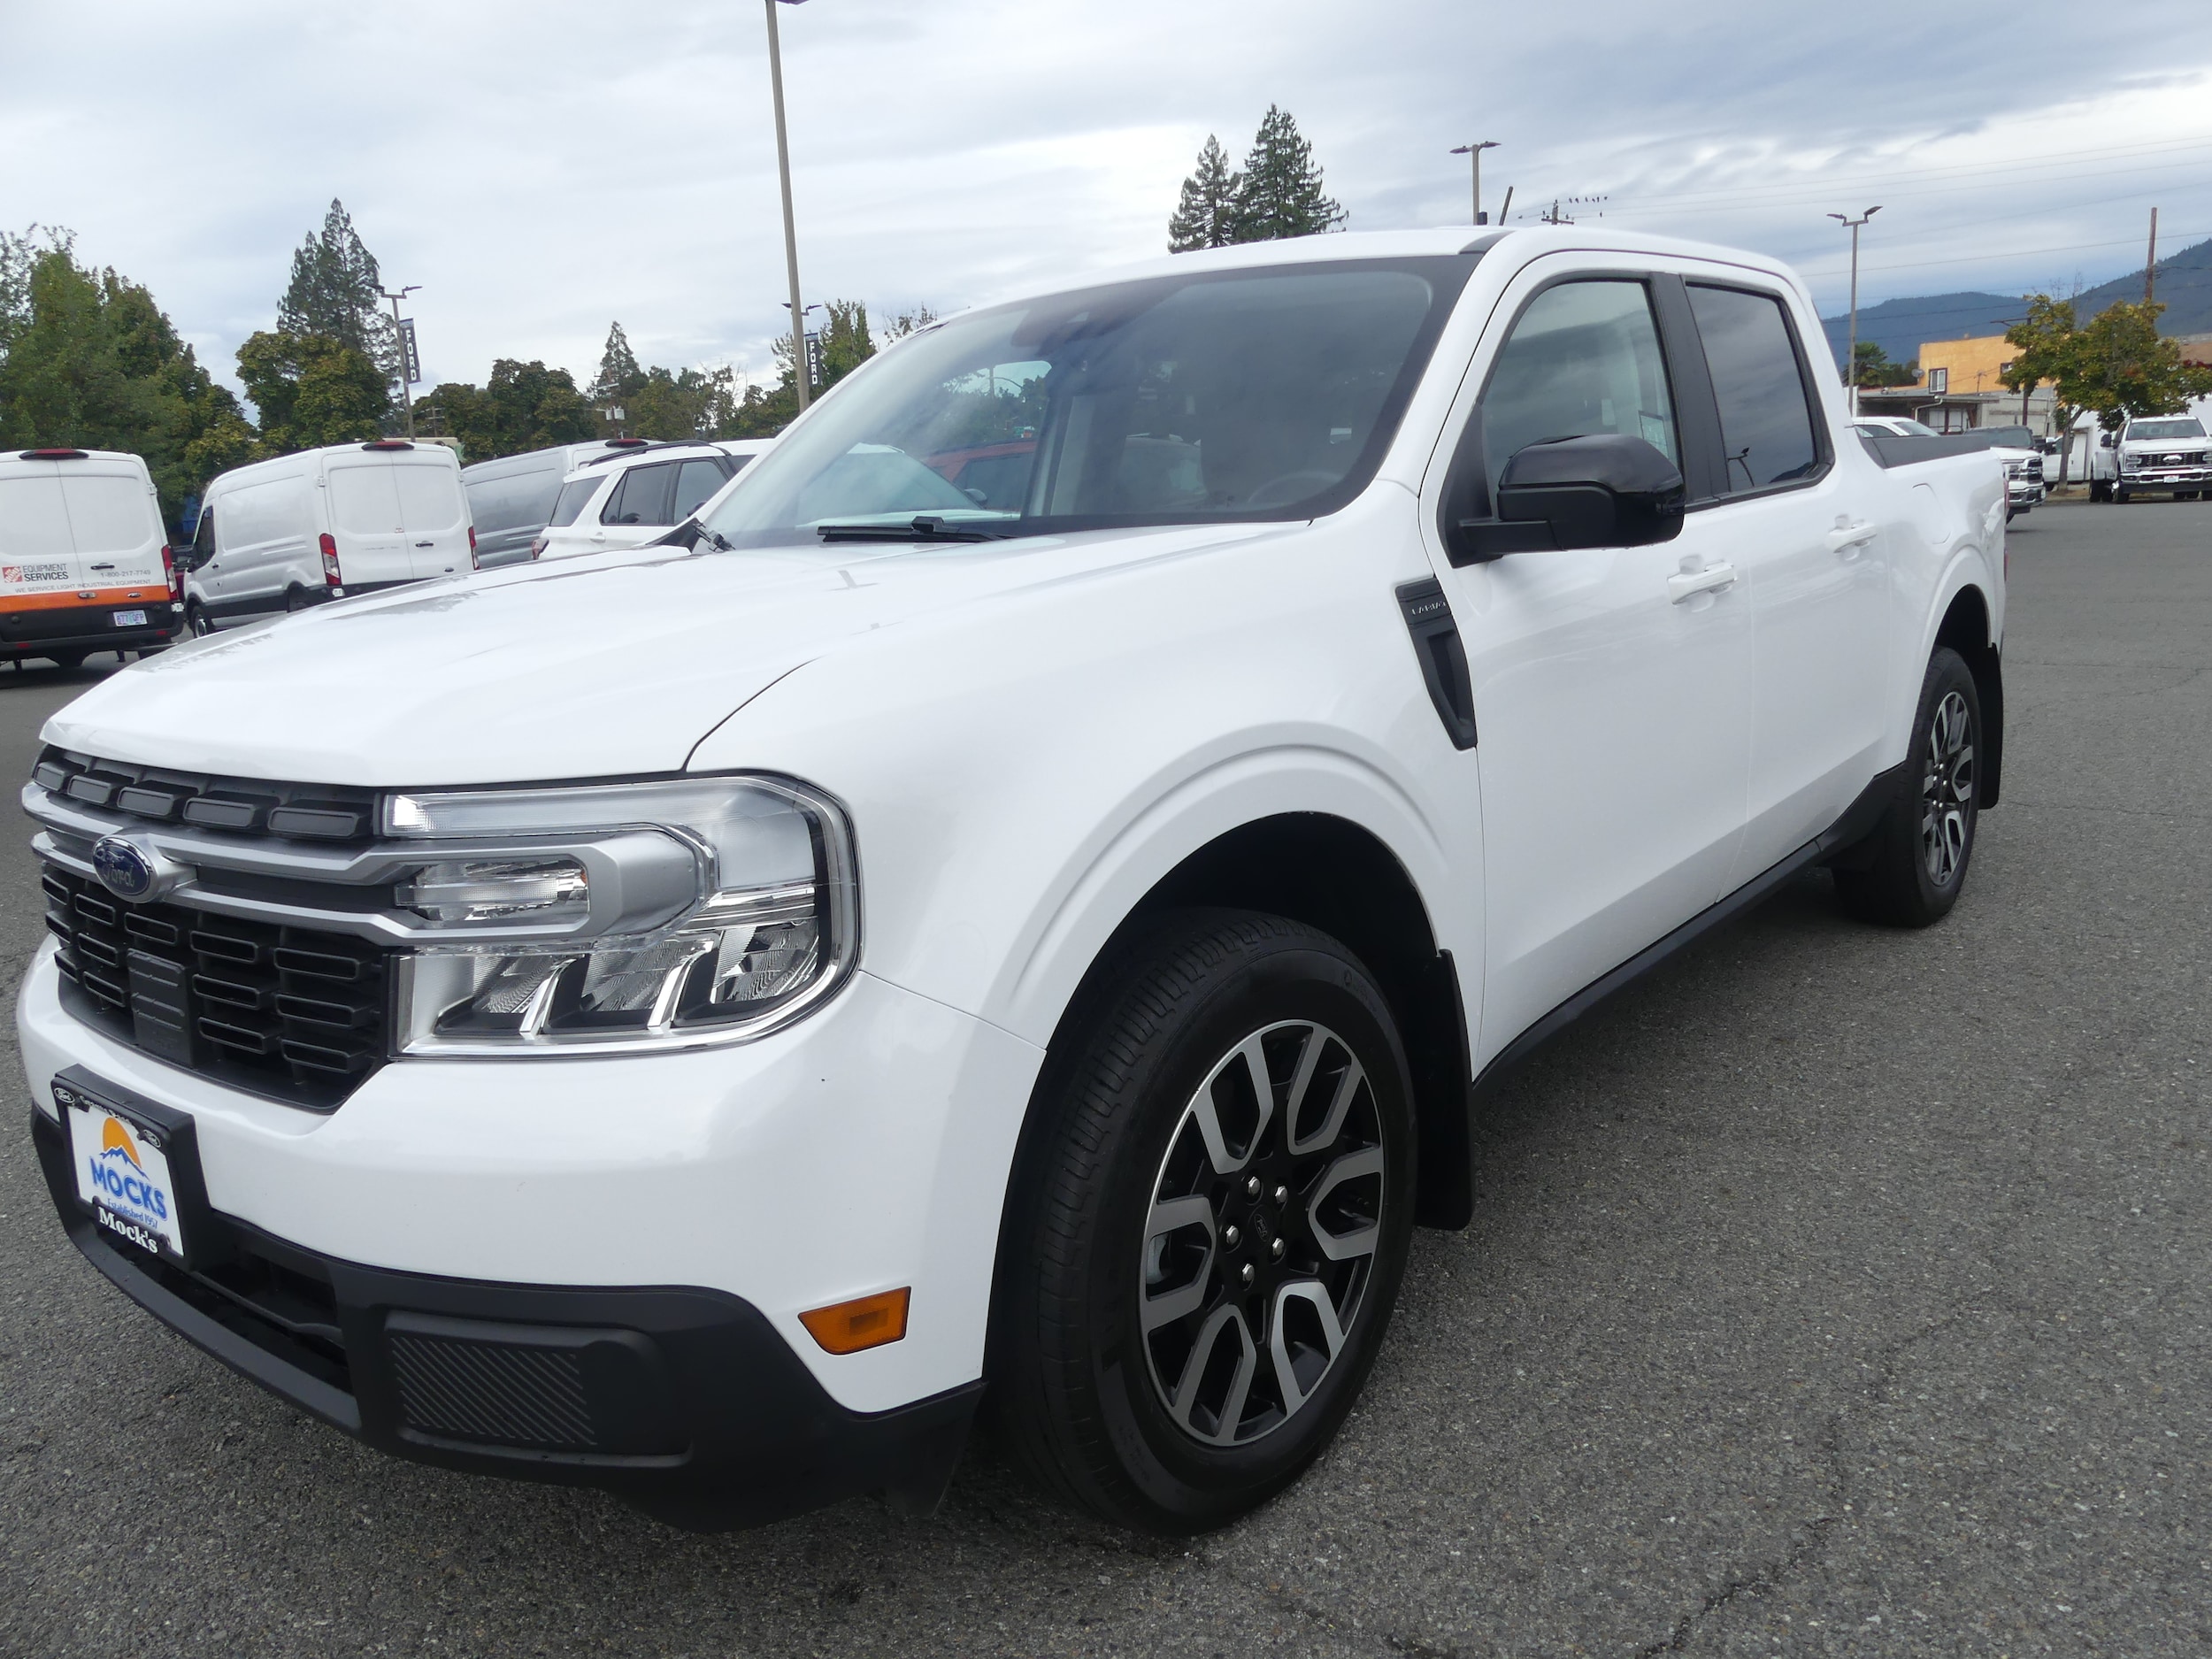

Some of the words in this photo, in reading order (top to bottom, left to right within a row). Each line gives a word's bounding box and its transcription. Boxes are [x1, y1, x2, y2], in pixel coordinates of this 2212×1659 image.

[405, 329, 417, 381] FORD
[22, 564, 67, 573] EQUIPMENT
[24, 572, 69, 582] SERVICES
[89, 1156, 167, 1221] MOCKS
[108, 1198, 142, 1221] Established
[97, 1206, 158, 1254] Mock's
